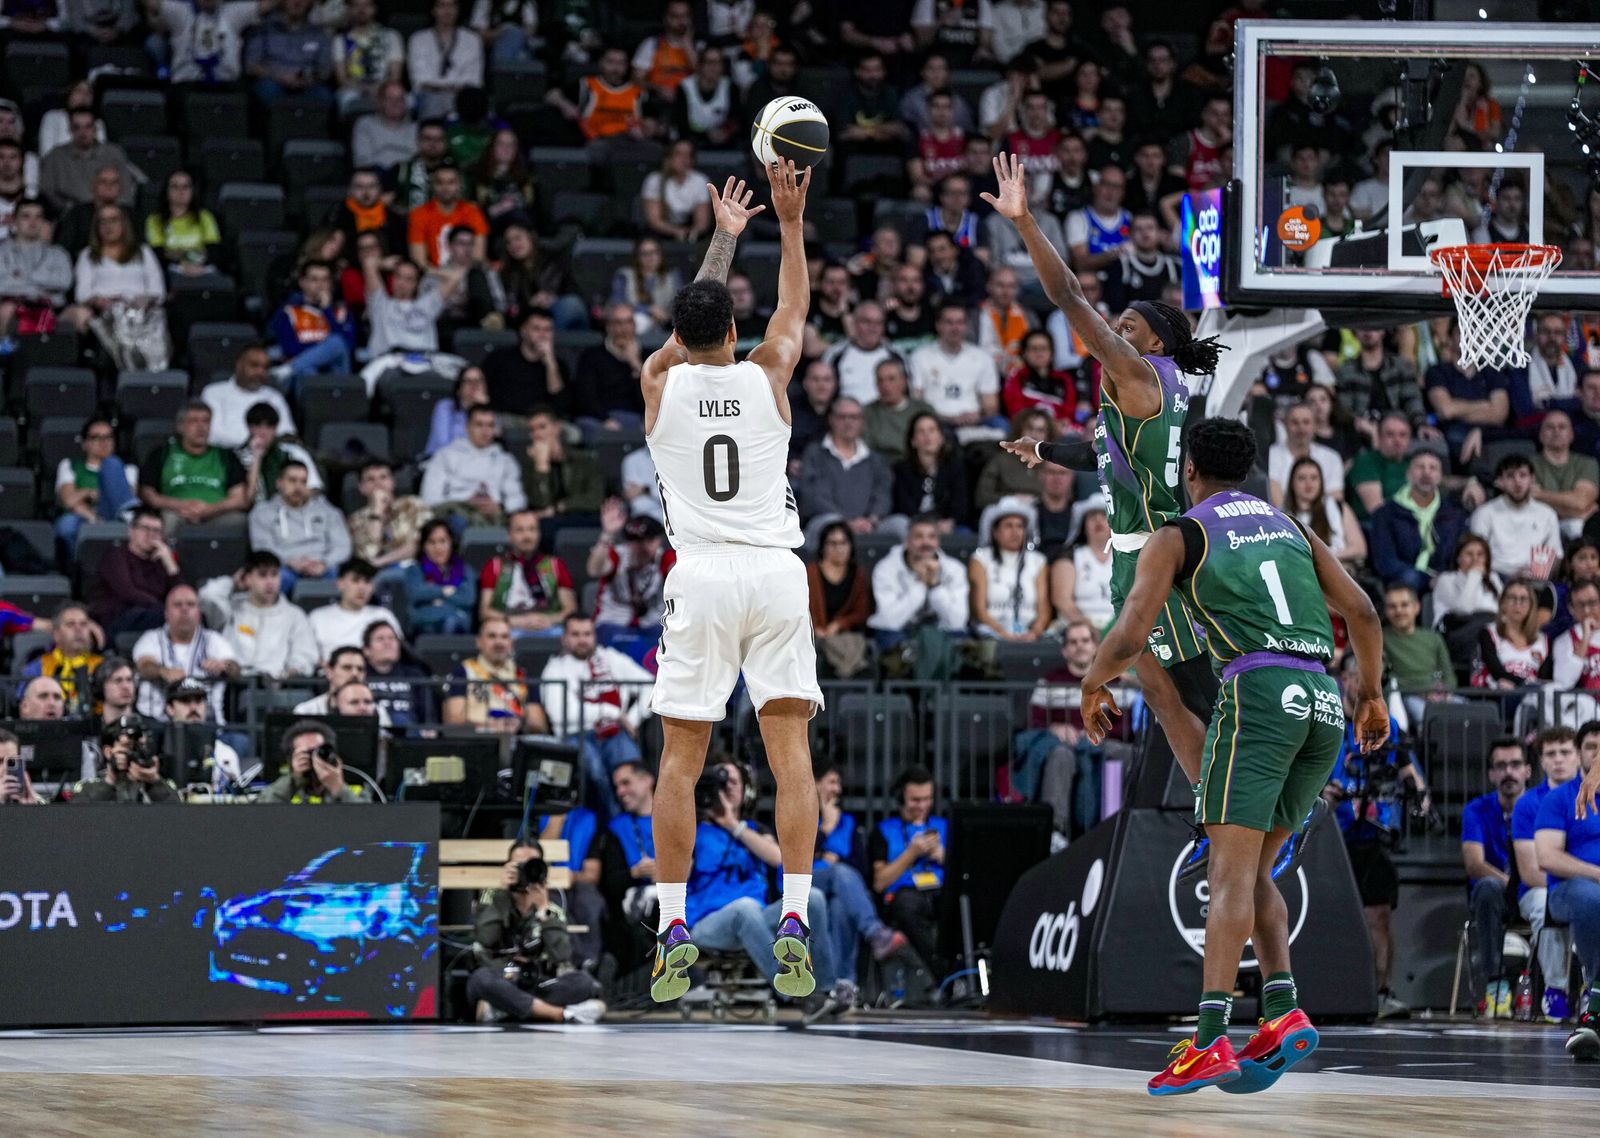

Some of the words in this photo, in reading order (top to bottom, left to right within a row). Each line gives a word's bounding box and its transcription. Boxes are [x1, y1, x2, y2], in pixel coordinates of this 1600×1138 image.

[1199, 204, 1219, 232] acb
[699, 399, 741, 417] LYLES
[703, 434, 740, 502] 0
[1164, 425, 1182, 488] 5
[1213, 500, 1274, 519] AUDIGE
[1259, 559, 1293, 625] 1
[1313, 711, 1345, 730] MÁLAG
[1314, 700, 1334, 714] DEL
[1028, 900, 1080, 973] acb
